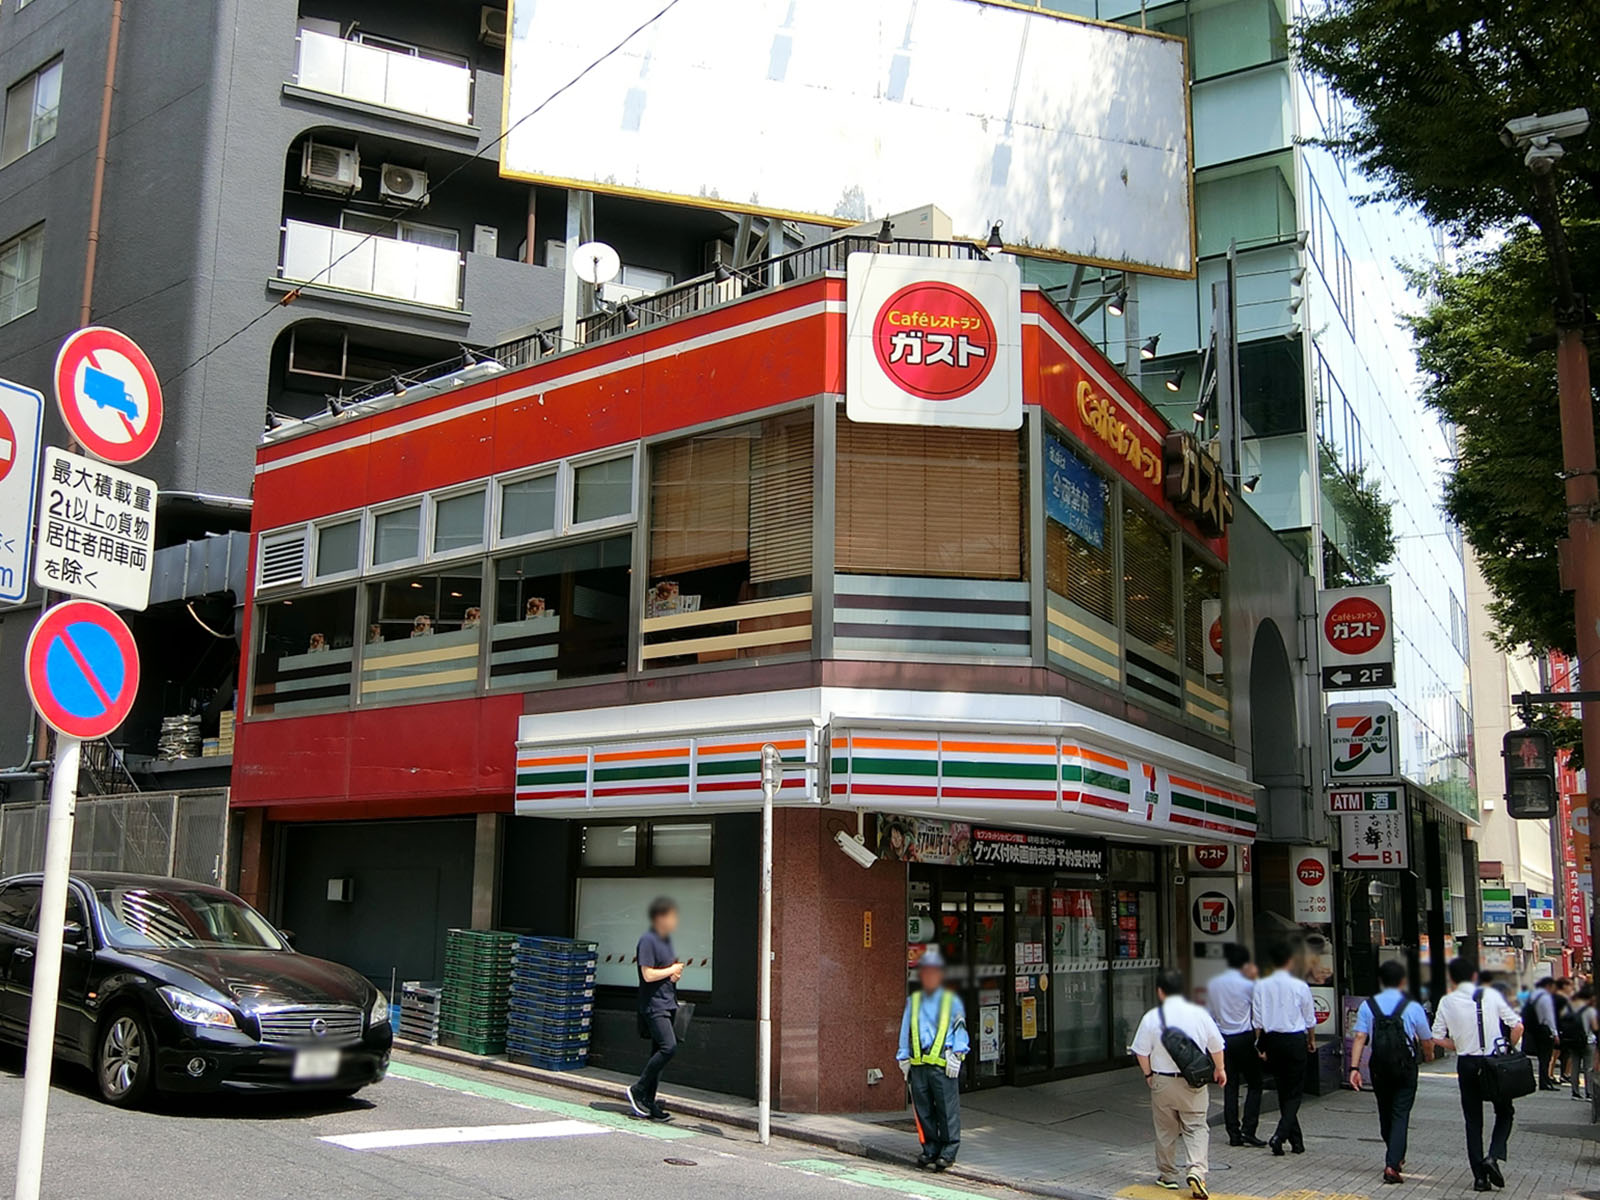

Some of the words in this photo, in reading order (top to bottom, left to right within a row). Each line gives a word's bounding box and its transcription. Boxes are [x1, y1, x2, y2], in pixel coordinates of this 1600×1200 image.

[888, 311, 981, 330] Caféレストラン
[889, 329, 987, 368] ガスト
[51, 458, 152, 513] 最大積載量
[48, 490, 150, 542] 2t以上の貨物
[46, 521, 147, 572] 居住者用車両
[44, 557, 99, 589] を除く
[1333, 621, 1380, 640] ガスト
[1359, 668, 1384, 683] 2F
[1334, 794, 1361, 810] ATM
[1372, 793, 1389, 810] 酒
[1382, 851, 1402, 865] B1
